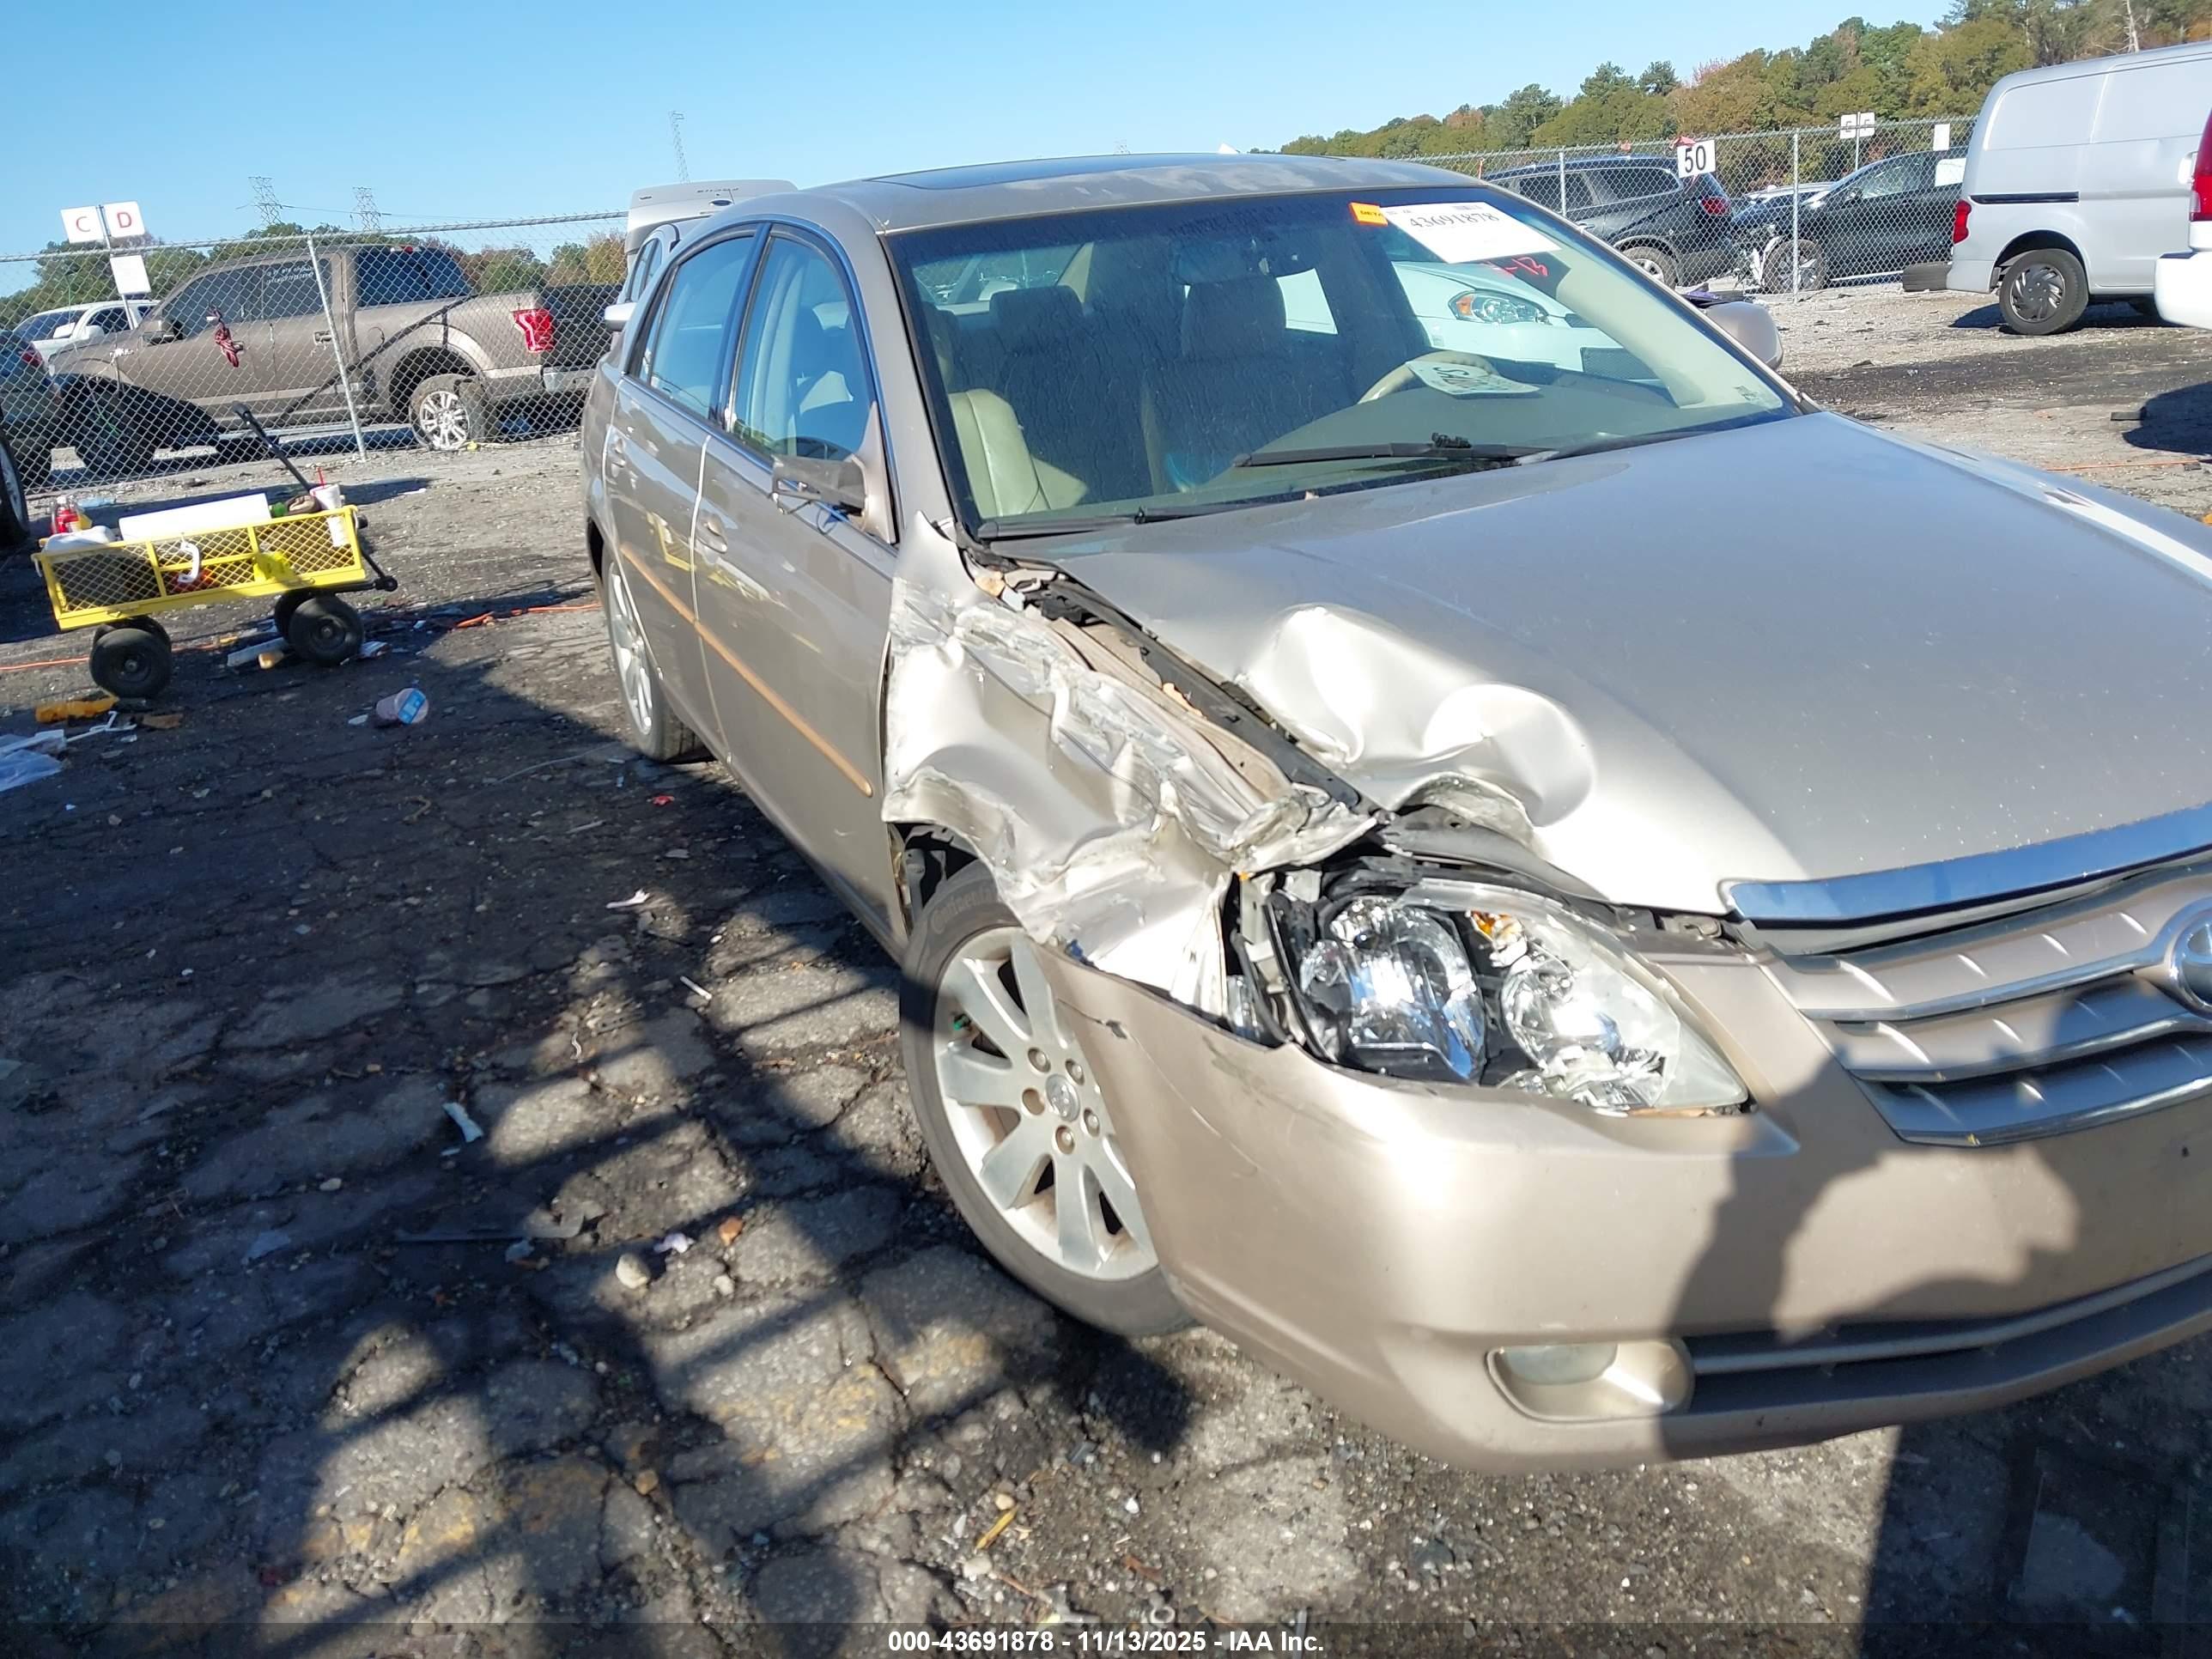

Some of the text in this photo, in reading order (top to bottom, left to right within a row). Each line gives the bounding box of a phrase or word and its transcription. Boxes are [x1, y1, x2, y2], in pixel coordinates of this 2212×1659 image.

[1684, 144, 1707, 173] 50
[75, 216, 91, 233] C
[116, 211, 132, 228] D
[1409, 212, 1500, 228] 43691878
